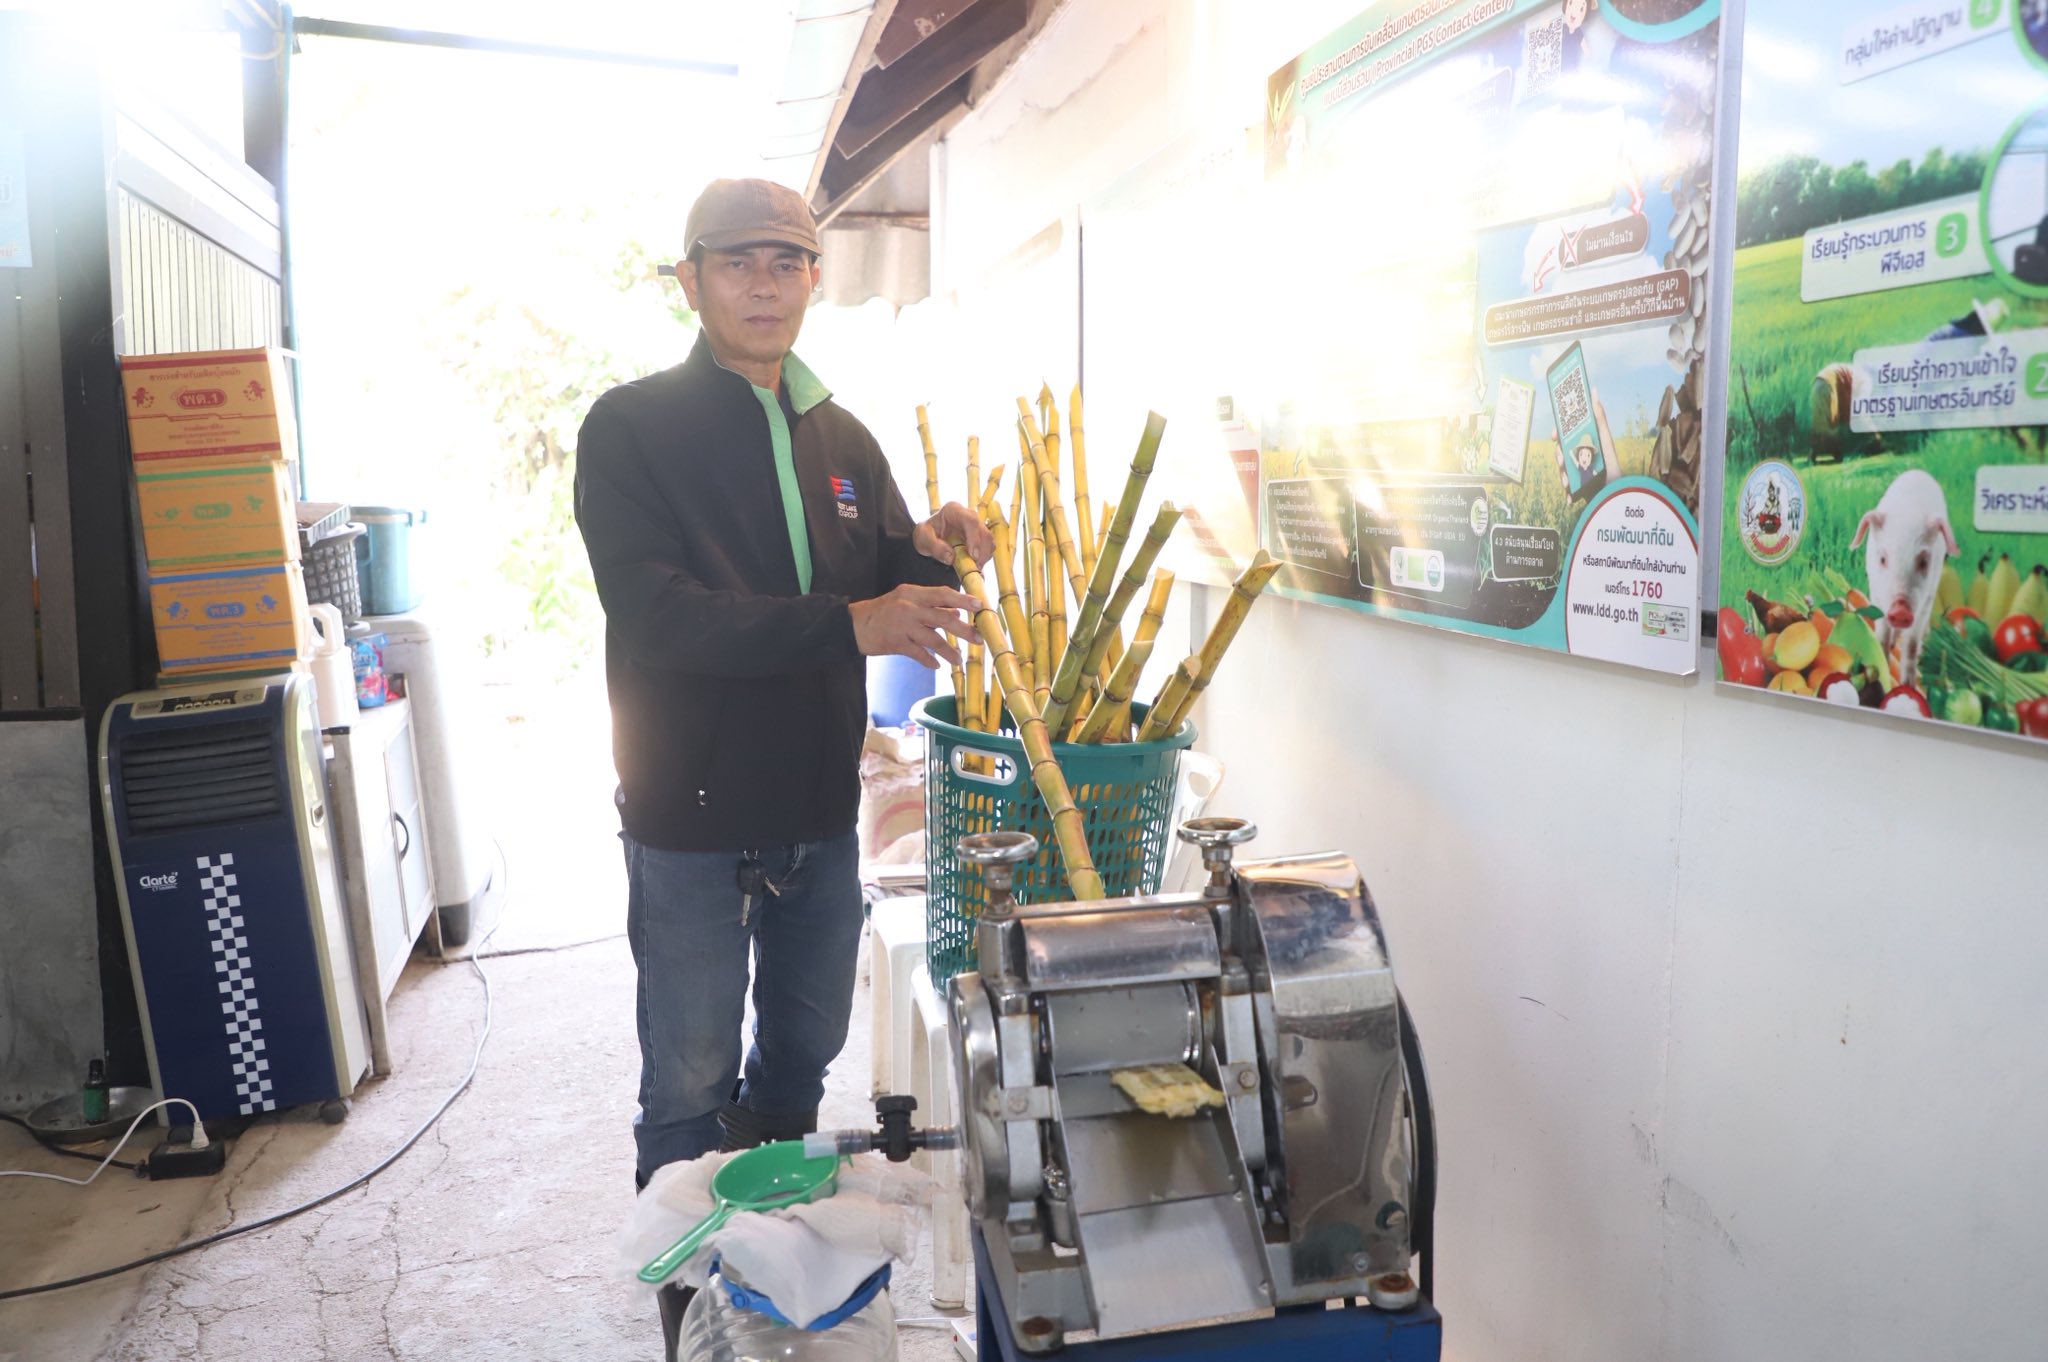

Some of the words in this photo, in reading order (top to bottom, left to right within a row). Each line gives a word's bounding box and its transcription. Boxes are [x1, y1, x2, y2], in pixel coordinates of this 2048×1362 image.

[1417, 30, 1433, 53] PGS
[1436, 11, 1471, 43] Contact
[1812, 221, 1926, 260] เรียนรู้กระบวนการ
[1945, 221, 1959, 252] 3
[1881, 251, 1925, 274] พีจีเอส
[1657, 278, 1679, 294] (GAP)
[1878, 346, 2017, 388] เรียนรู้ทำความเข้าใจ
[1853, 381, 2016, 418] มาตรฐานเกษตรอินทรีย์
[1981, 485, 2048, 511] วิเคราะห์
[1625, 506, 1645, 518] ติดต่อ
[1597, 522, 1674, 547] กรมพัฒนาที่ดิน
[1583, 556, 1686, 575] หรือสถานีพัฒนาที่ดินใกล้บ้านท่าน
[1605, 581, 1630, 596] เบอร์โทร
[1632, 580, 1663, 599] 1760
[1573, 602, 1639, 623] www.ldd.go.th
